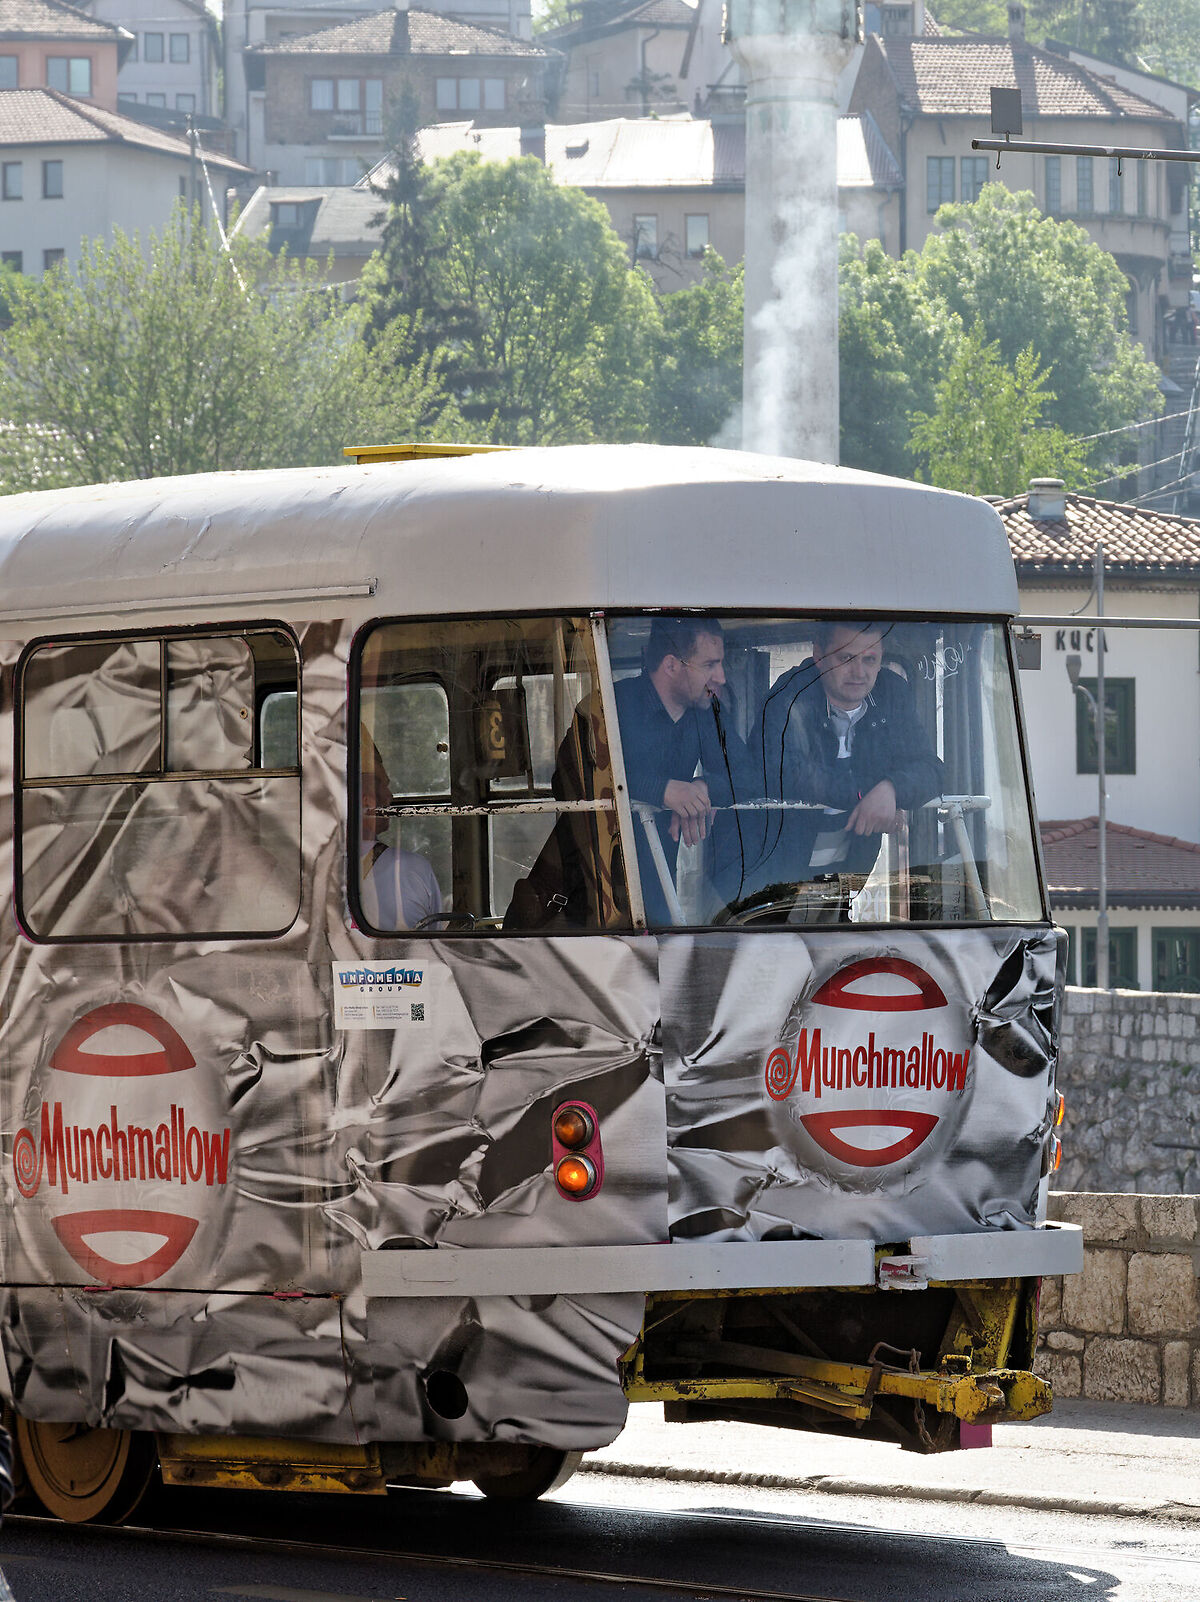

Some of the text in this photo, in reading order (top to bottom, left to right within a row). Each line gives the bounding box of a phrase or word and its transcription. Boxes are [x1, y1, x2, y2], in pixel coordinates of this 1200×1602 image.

[341, 972, 422, 984] INFOMEDIA
[765, 1027, 971, 1101] Munchmallow
[13, 1101, 231, 1199] Munchmallow
